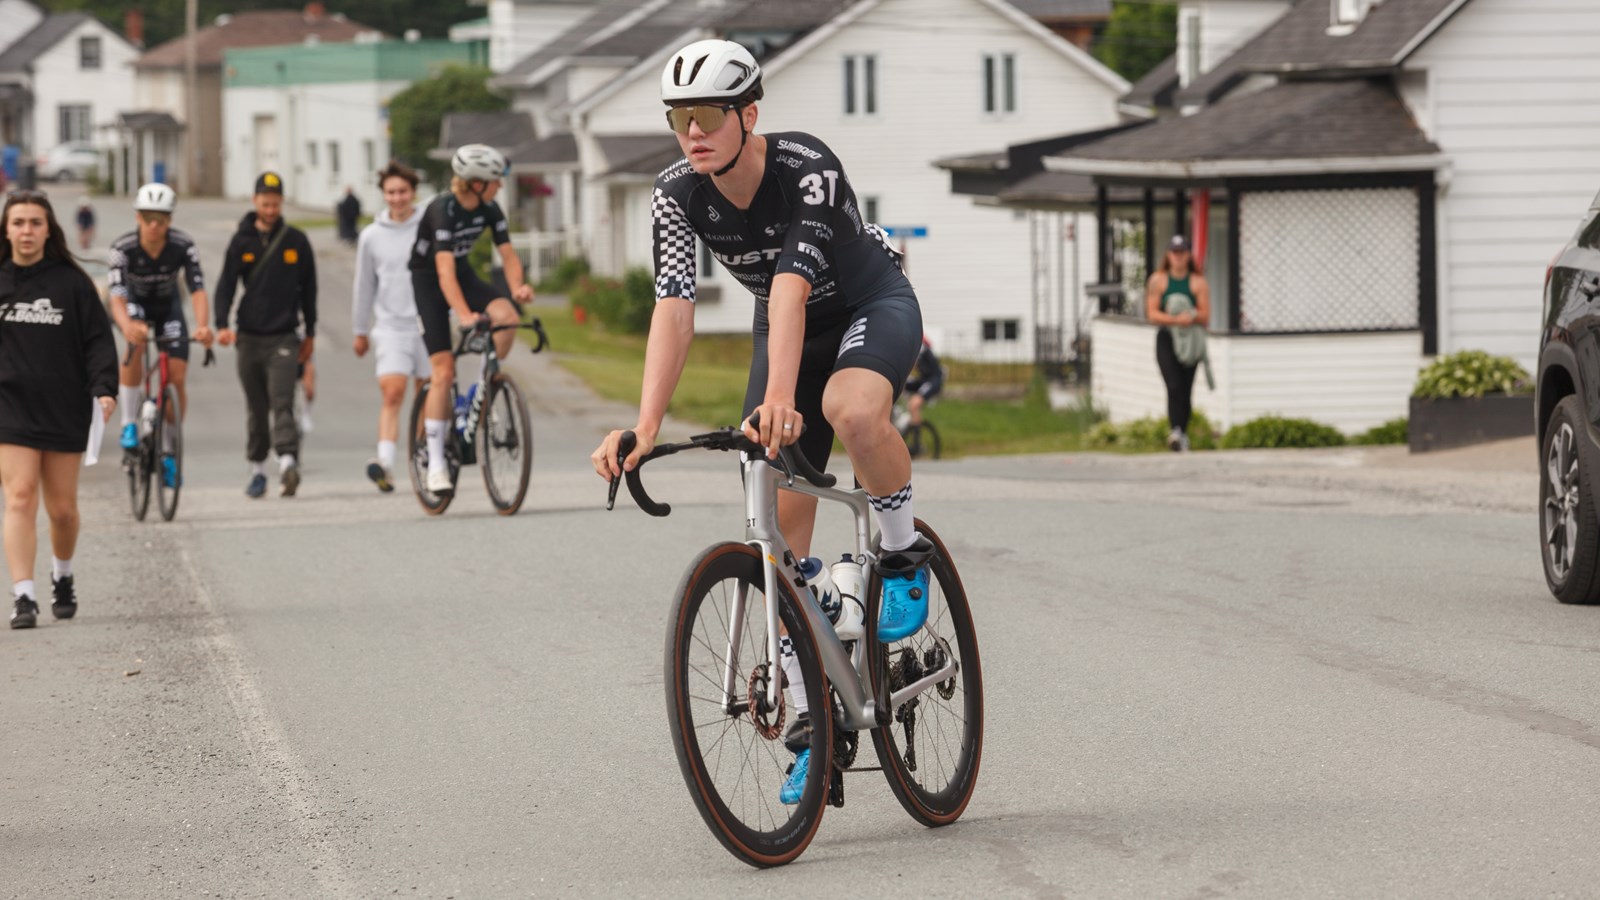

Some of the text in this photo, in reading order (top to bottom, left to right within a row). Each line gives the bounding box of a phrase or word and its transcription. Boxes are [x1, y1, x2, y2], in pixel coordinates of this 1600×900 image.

[777, 139, 823, 160] SHIMANO
[663, 166, 696, 183] JAKRO
[798, 169, 839, 207] 3T
[746, 517, 756, 529] 3T
